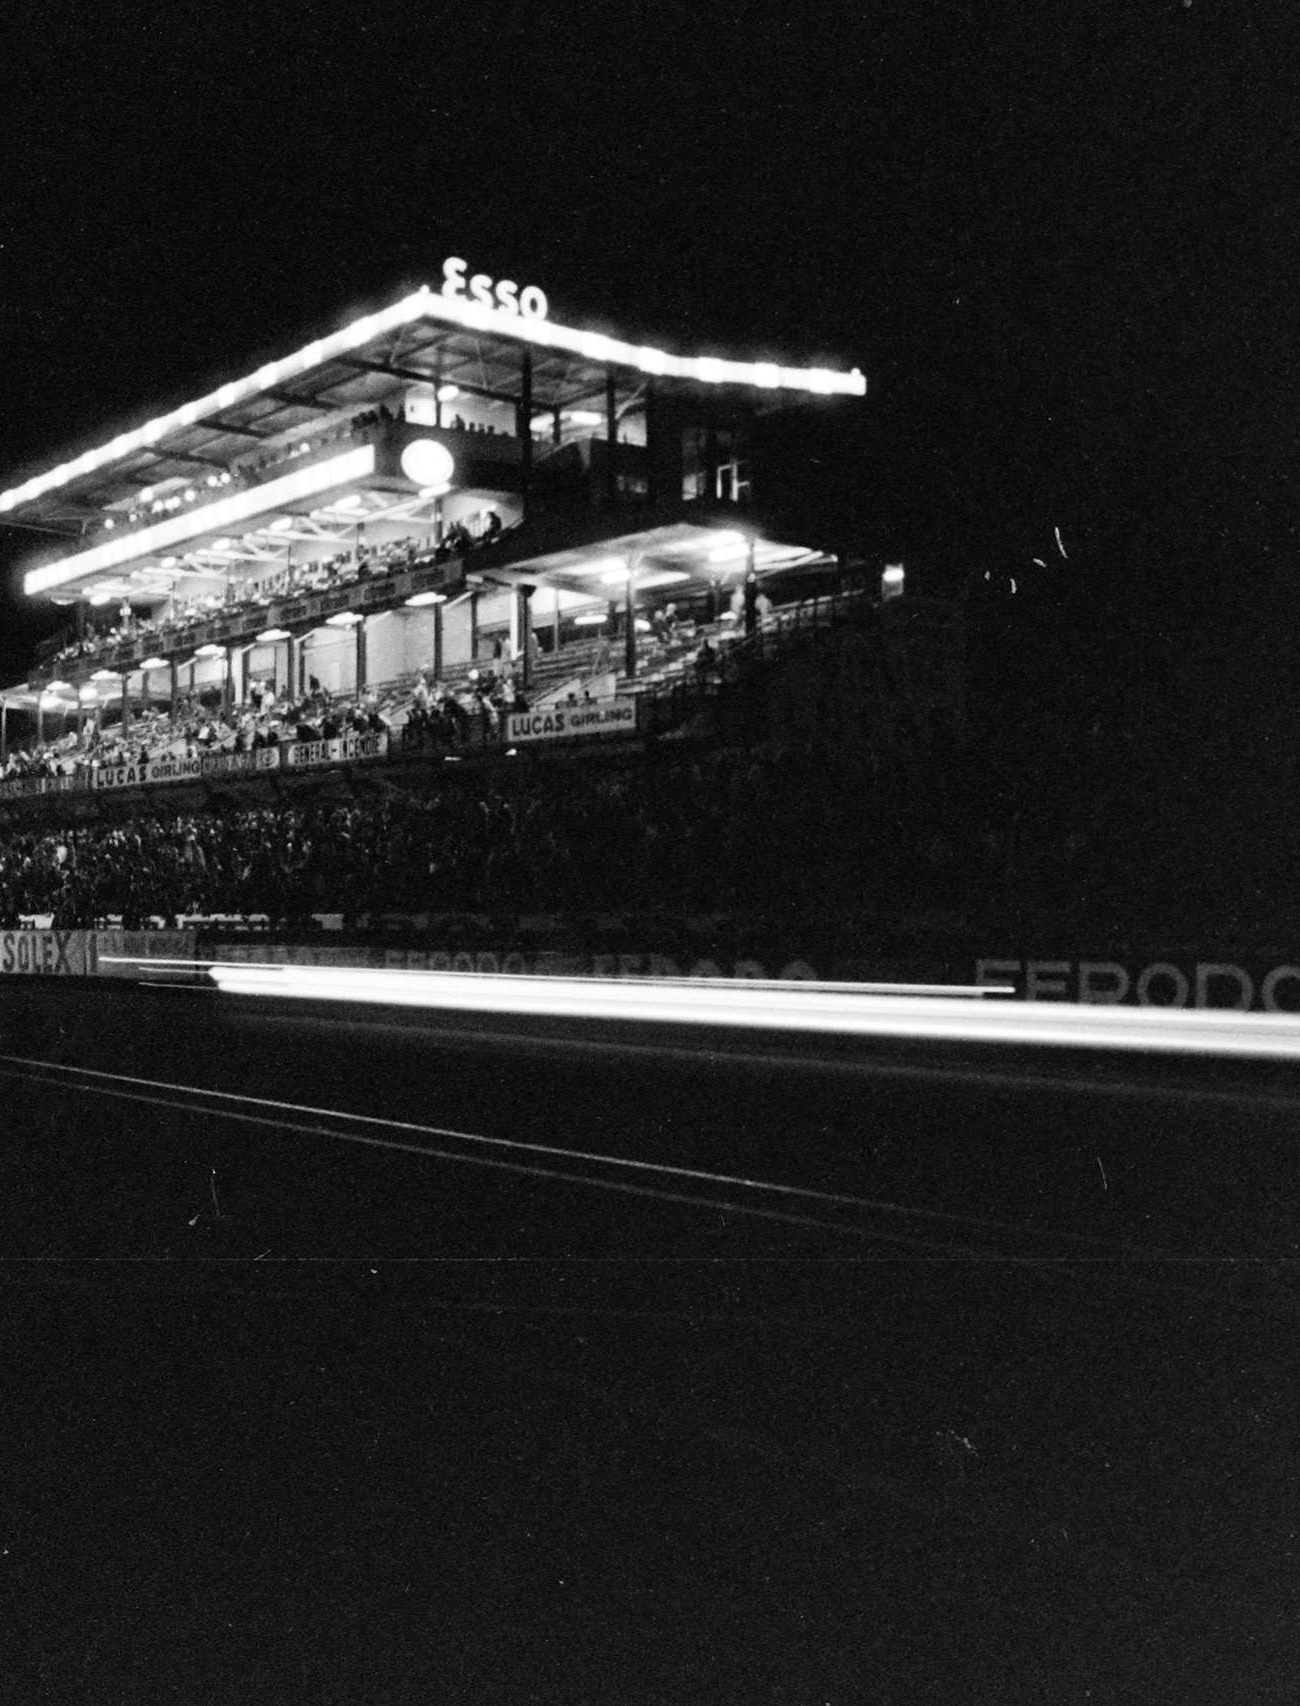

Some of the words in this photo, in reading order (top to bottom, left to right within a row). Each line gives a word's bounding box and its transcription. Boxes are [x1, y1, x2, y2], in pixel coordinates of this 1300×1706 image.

[512, 713, 565, 737] LUCAS
[570, 707, 633, 727] GIRLING
[96, 765, 148, 786] LUCAS
[151, 759, 200, 779] GIRLING
[2, 931, 73, 976] SOLEX
